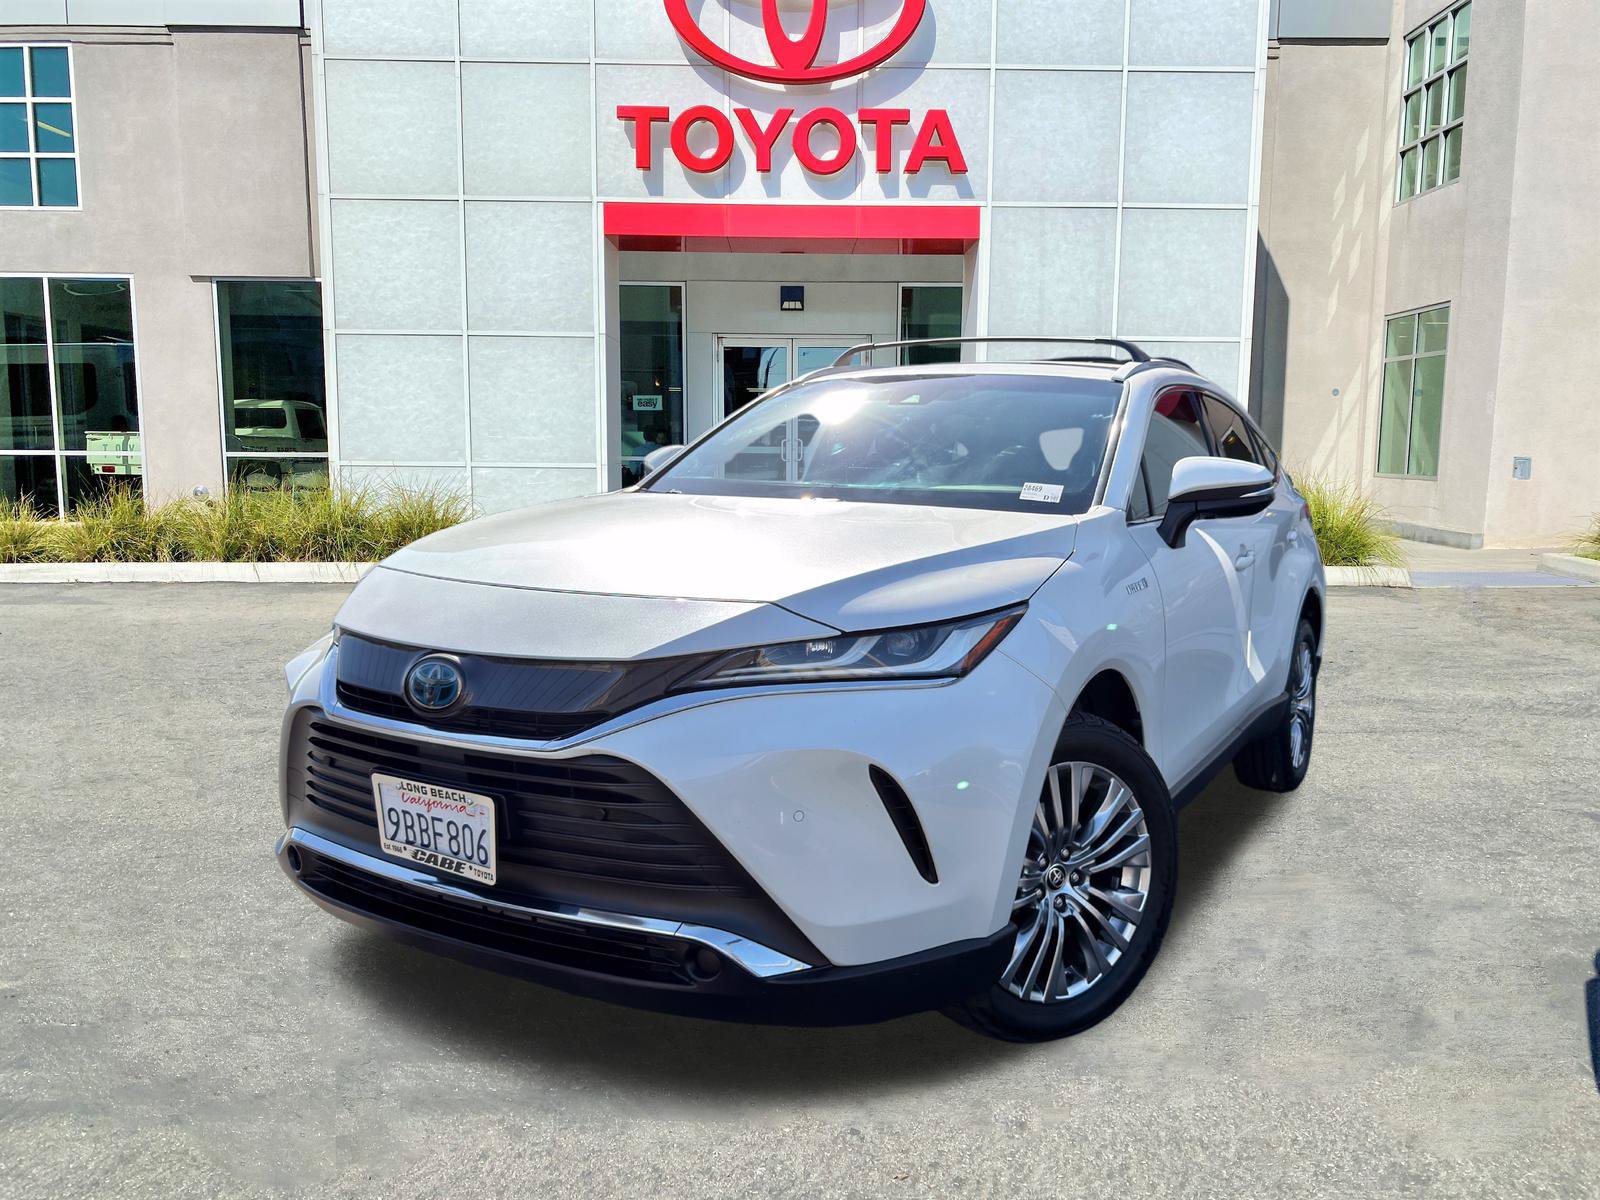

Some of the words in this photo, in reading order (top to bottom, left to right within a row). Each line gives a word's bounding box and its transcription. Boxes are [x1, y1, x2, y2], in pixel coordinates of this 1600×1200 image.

[616, 105, 969, 175] TOYOTA
[637, 400, 658, 409] easy
[400, 781, 428, 795] LONG
[430, 787, 467, 804] BEACH
[401, 792, 475, 817] California
[387, 807, 489, 865] 9BBF806
[411, 849, 467, 874] CABE
[473, 868, 494, 881] TOYOTA
